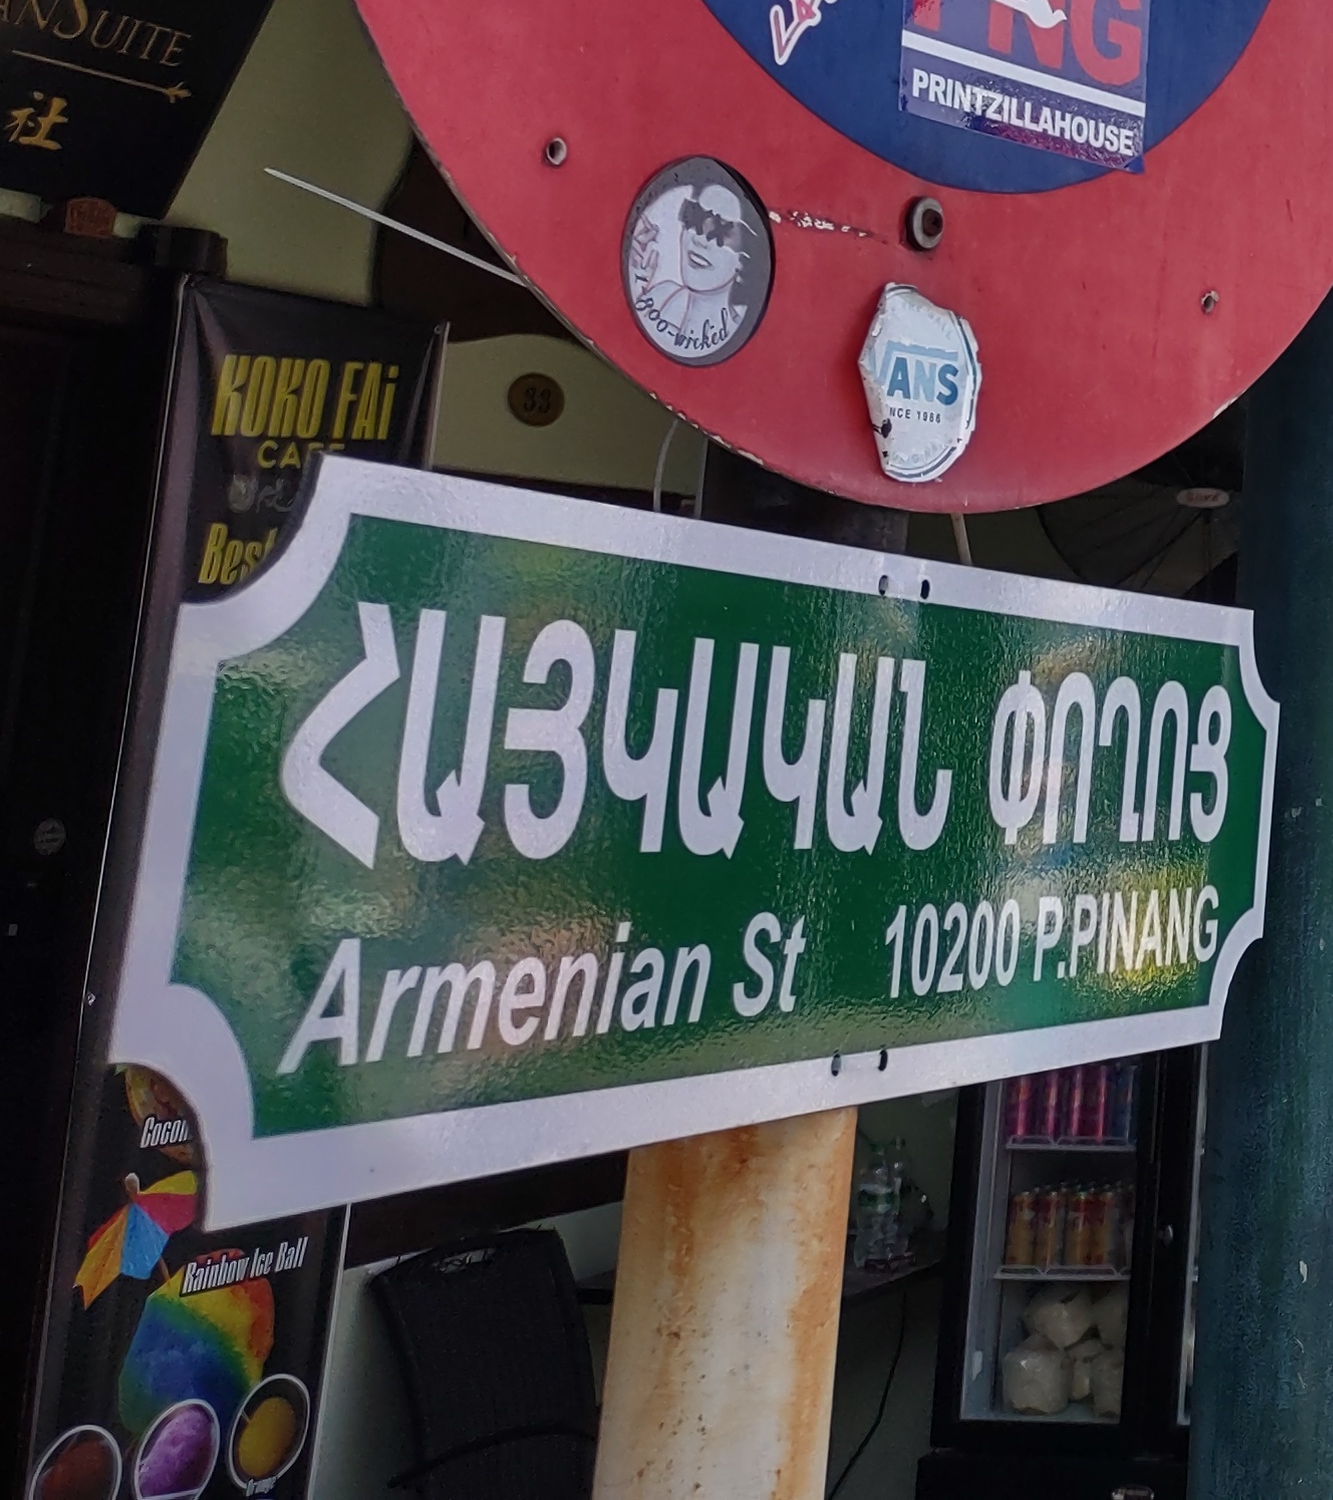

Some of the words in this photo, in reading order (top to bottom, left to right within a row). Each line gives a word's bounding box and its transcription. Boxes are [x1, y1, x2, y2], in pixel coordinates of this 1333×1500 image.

[911, 68, 1135, 157] PRINTZILLAHOUSE
[210, 354, 331, 438] KOKO
[888, 406, 911, 420] NCE
[281, 600, 953, 870] ՀԱՅԿԱԿԱՆ
[989, 669, 1232, 848] ՓՈՂՈՑ
[276, 923, 712, 1075] Armenian
[732, 912, 806, 1018] St
[884, 897, 1019, 1000] 10200
[1033, 885, 1219, 984] P.PINANG
[180, 1256, 250, 1294] Rainbow
[249, 1247, 273, 1279] Ice
[274, 1236, 309, 1273] Ball
